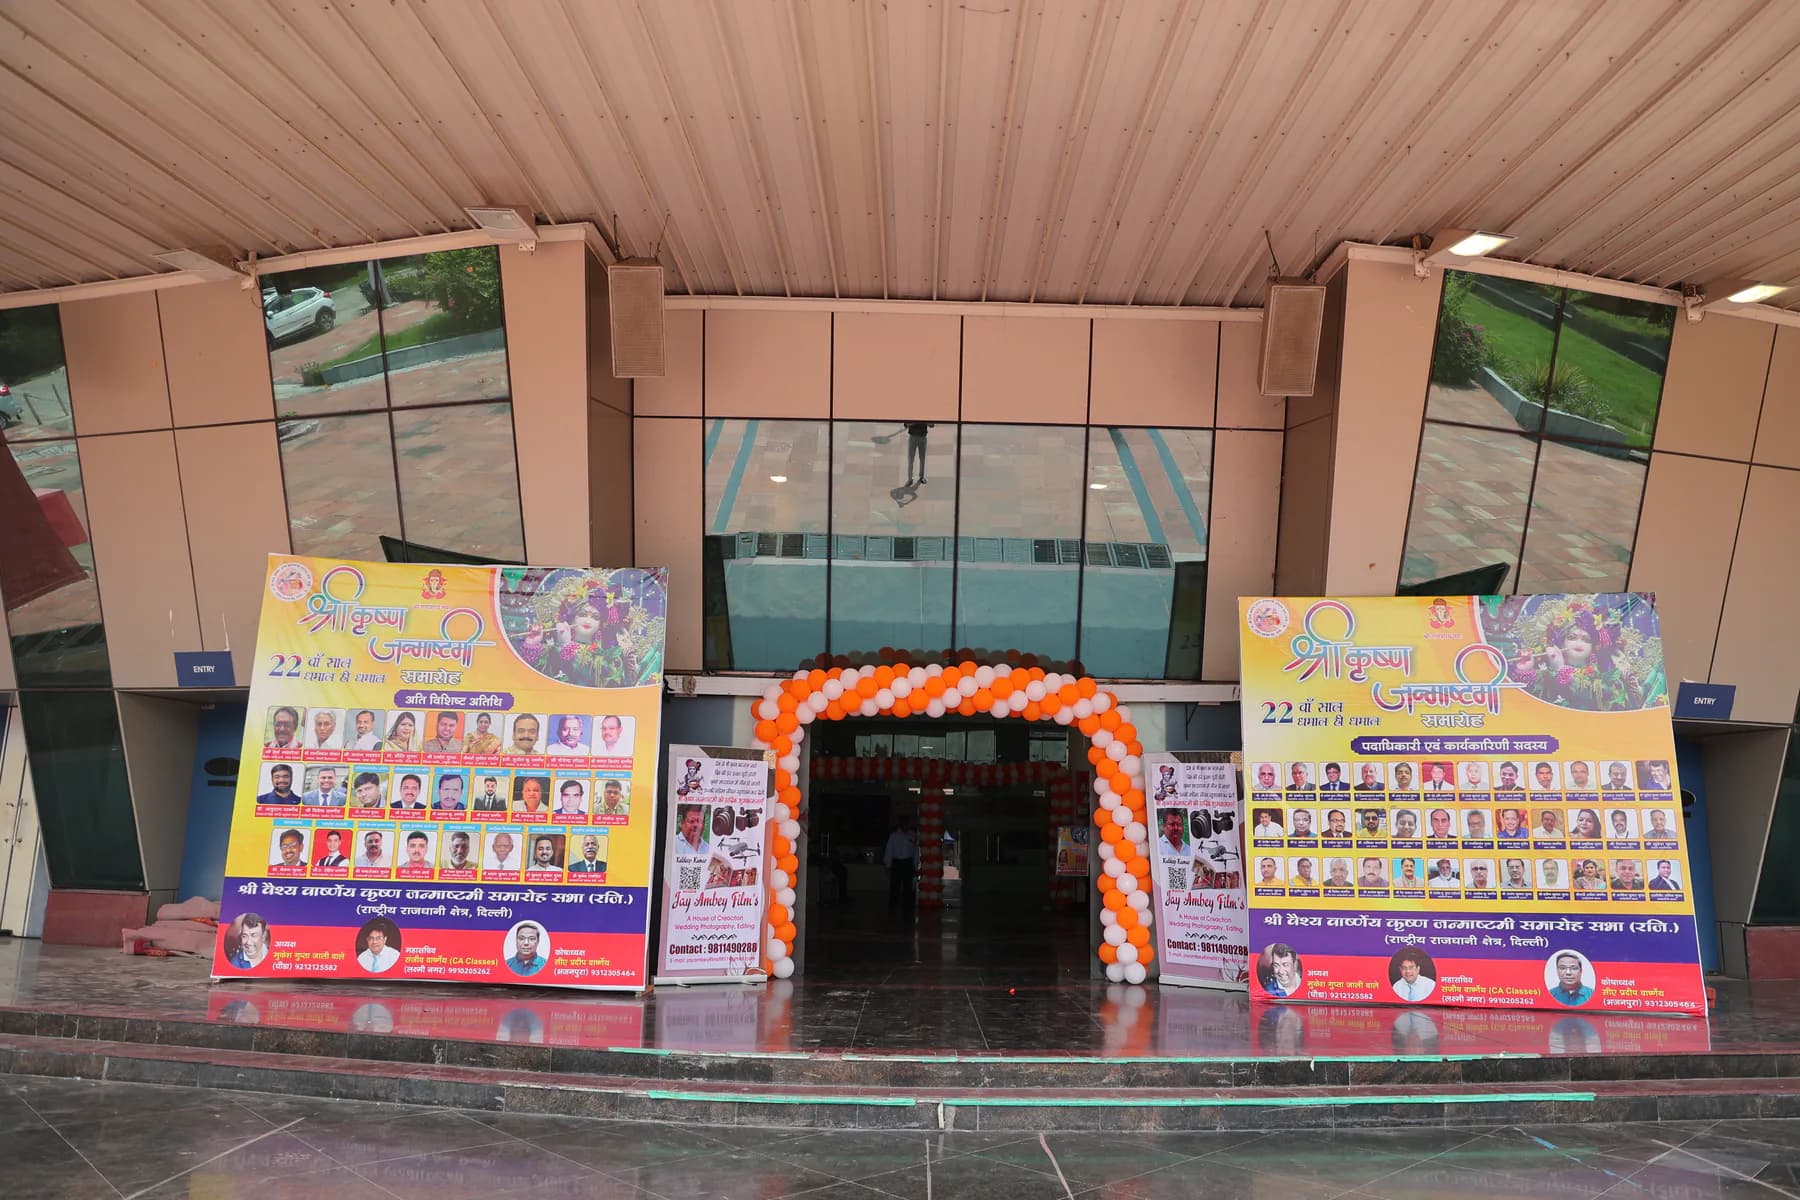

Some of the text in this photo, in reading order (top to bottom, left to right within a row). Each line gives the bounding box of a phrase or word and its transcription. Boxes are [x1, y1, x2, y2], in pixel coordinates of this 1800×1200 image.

[298, 566, 365, 633] श्री
[350, 607, 408, 635] कृष्ण
[369, 608, 496, 667] जन्माष्टमी
[1283, 600, 1356, 682] श्री
[1344, 646, 1413, 682] कृष्ण
[269, 654, 302, 677] 22
[326, 657, 352, 668] साल
[340, 671, 350, 683] ही
[400, 668, 463, 685] समारोह
[1372, 643, 1526, 715] जन्माष्टमी
[405, 691, 503, 707] अति विशिष्ट अतिथि
[1261, 701, 1294, 724] 22
[1318, 702, 1343, 713] साल
[1333, 714, 1344, 727] ही
[1421, 713, 1485, 728] समारोह
[1362, 737, 1548, 753] पदाधिकारी एवं कार्यकारिणी सदस्य
[238, 882, 634, 905] श्री वैश्य वार्ष्णेय कृष्ण जन्माष्टमी समारोह सभा (रजि.)
[672, 891, 759, 912] Jay Ambey Film's
[1166, 891, 1245, 914] Jay Ambey Film's
[356, 904, 513, 919] (राष्ट्रीय राजधानी क्षेत्र, दिल्ली)
[1169, 920, 1192, 930] Wedding
[1226, 925, 1244, 934] Editing
[1264, 913, 1680, 934] श्री वैश्य वार्ष्णेय कृष्ण जन्माष्टमी समारोह सभा (रजि.)
[670, 944, 702, 954] Contact
[708, 942, 758, 954] 9811490288
[1168, 938, 1197, 950] Contact
[1201, 942, 1248, 956] 9811490288
[1384, 934, 1550, 949] (राष्ट्रीय राजधानी क्षेत्र, दिल्ली)
[405, 946, 436, 954] महासचिव
[450, 957, 464, 966] (CA
[466, 958, 498, 967] Classes)
[448, 967, 491, 975] 9910205262
[1440, 974, 1473, 984] महासचिव
[1488, 986, 1504, 995] (CA
[1506, 986, 1541, 996] Classes)
[1488, 996, 1534, 1004] 9910205262
